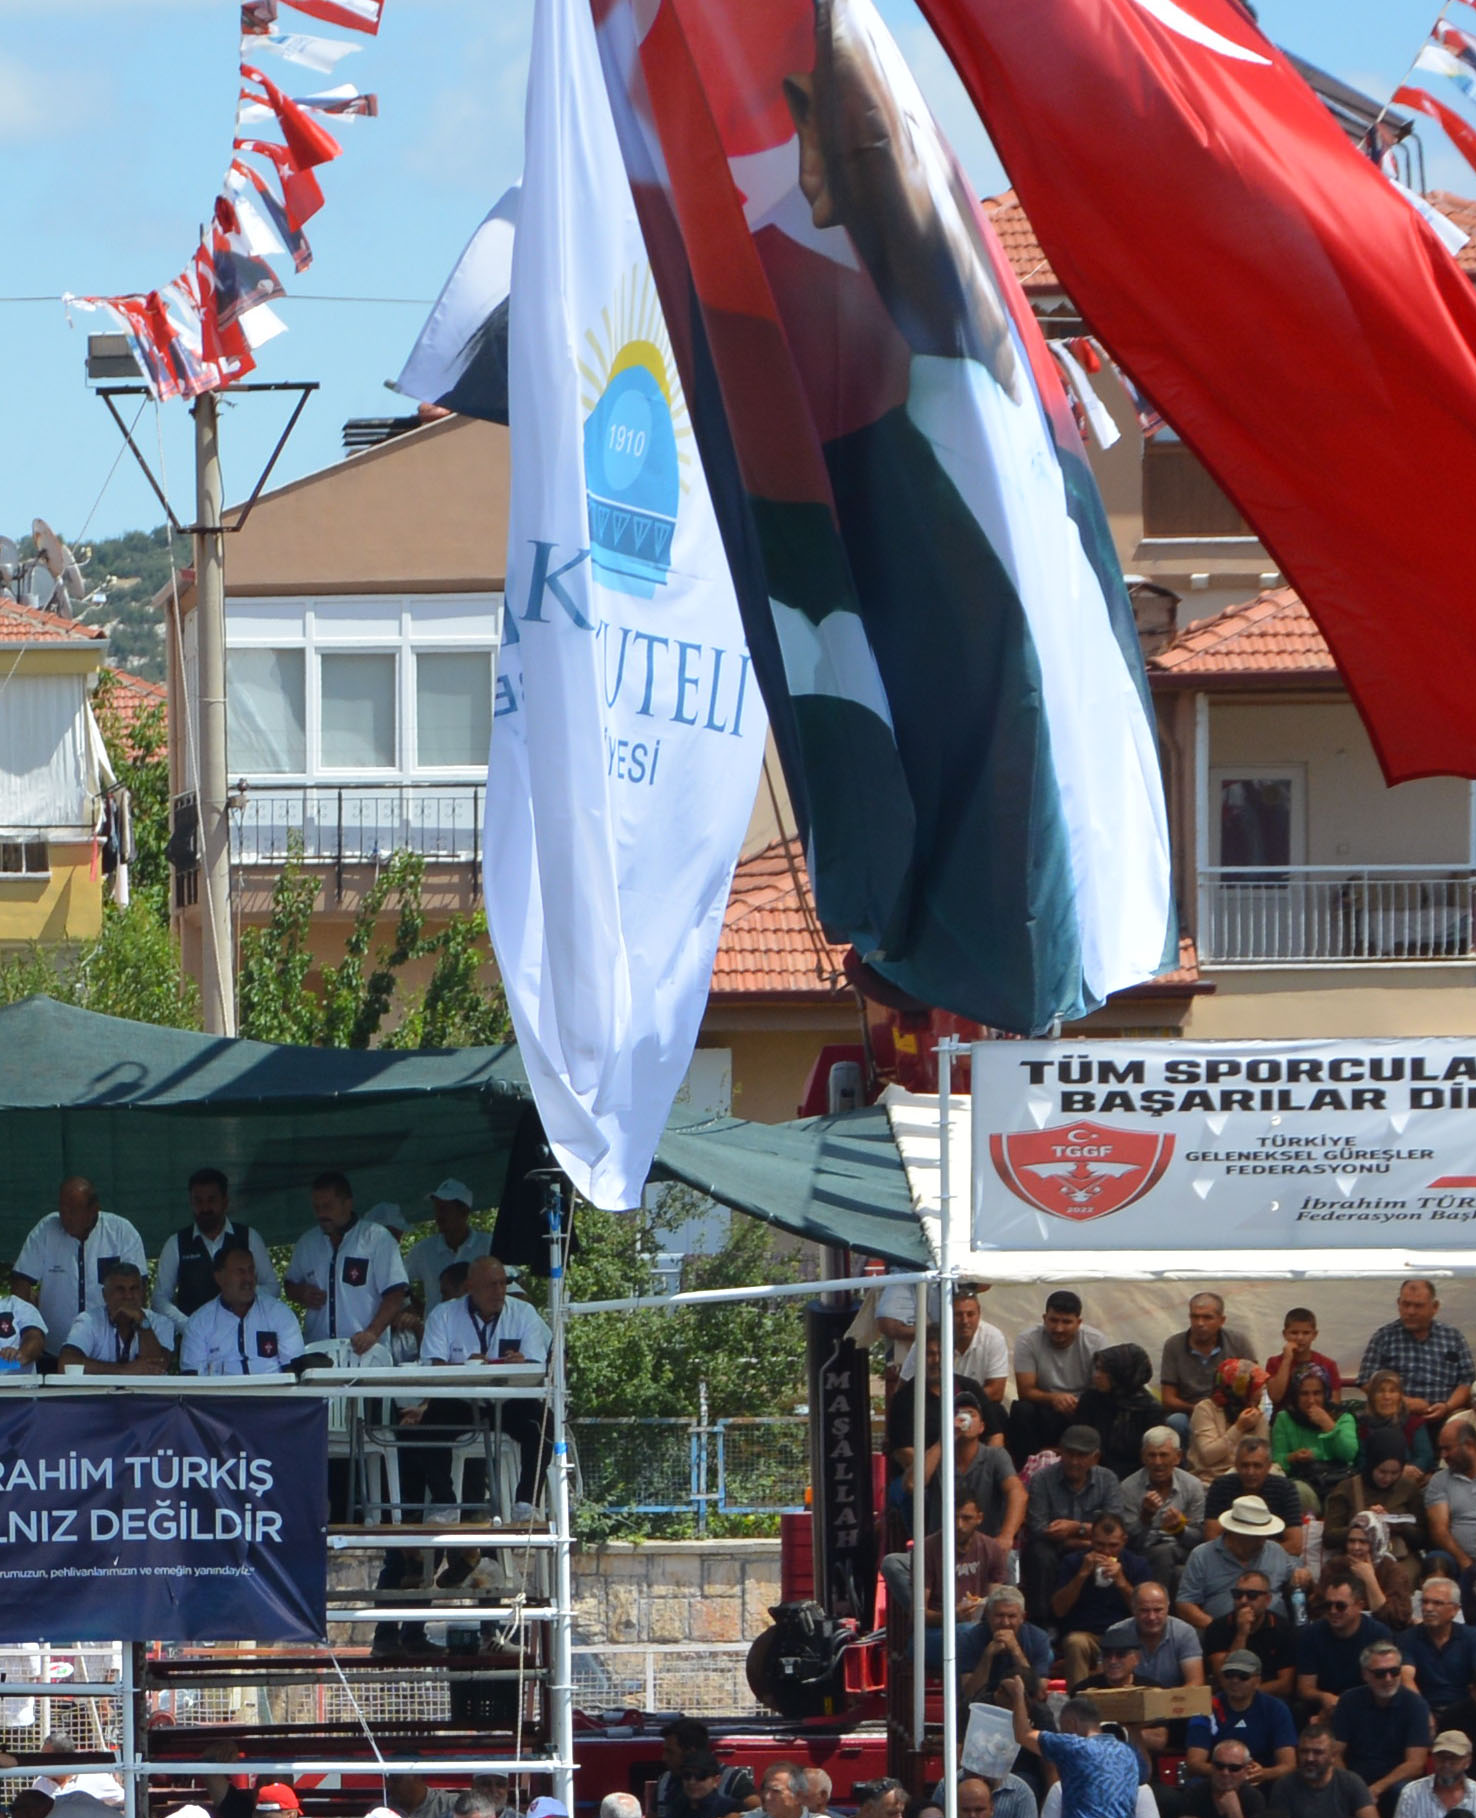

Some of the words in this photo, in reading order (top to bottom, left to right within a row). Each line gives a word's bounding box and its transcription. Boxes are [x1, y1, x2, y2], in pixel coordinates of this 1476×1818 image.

[607, 423, 646, 458] 1910
[1019, 1054, 1145, 1085] TÜM
[1060, 1087, 1387, 1117] BAŞARILAR
[1256, 1133, 1357, 1148] TÜRKİYE
[1051, 1145, 1113, 1158] TGGF
[1185, 1150, 1318, 1162] GELENEKSEL
[1324, 1147, 1435, 1162] GÜREŞLER
[1225, 1162, 1391, 1175] FEDERASYONU
[1299, 1195, 1407, 1210] İbrahim
[1295, 1209, 1426, 1222] Federasyon
[124, 1448, 274, 1498] TÜRKİŞ
[90, 1500, 284, 1545] DEĞİLDİR
